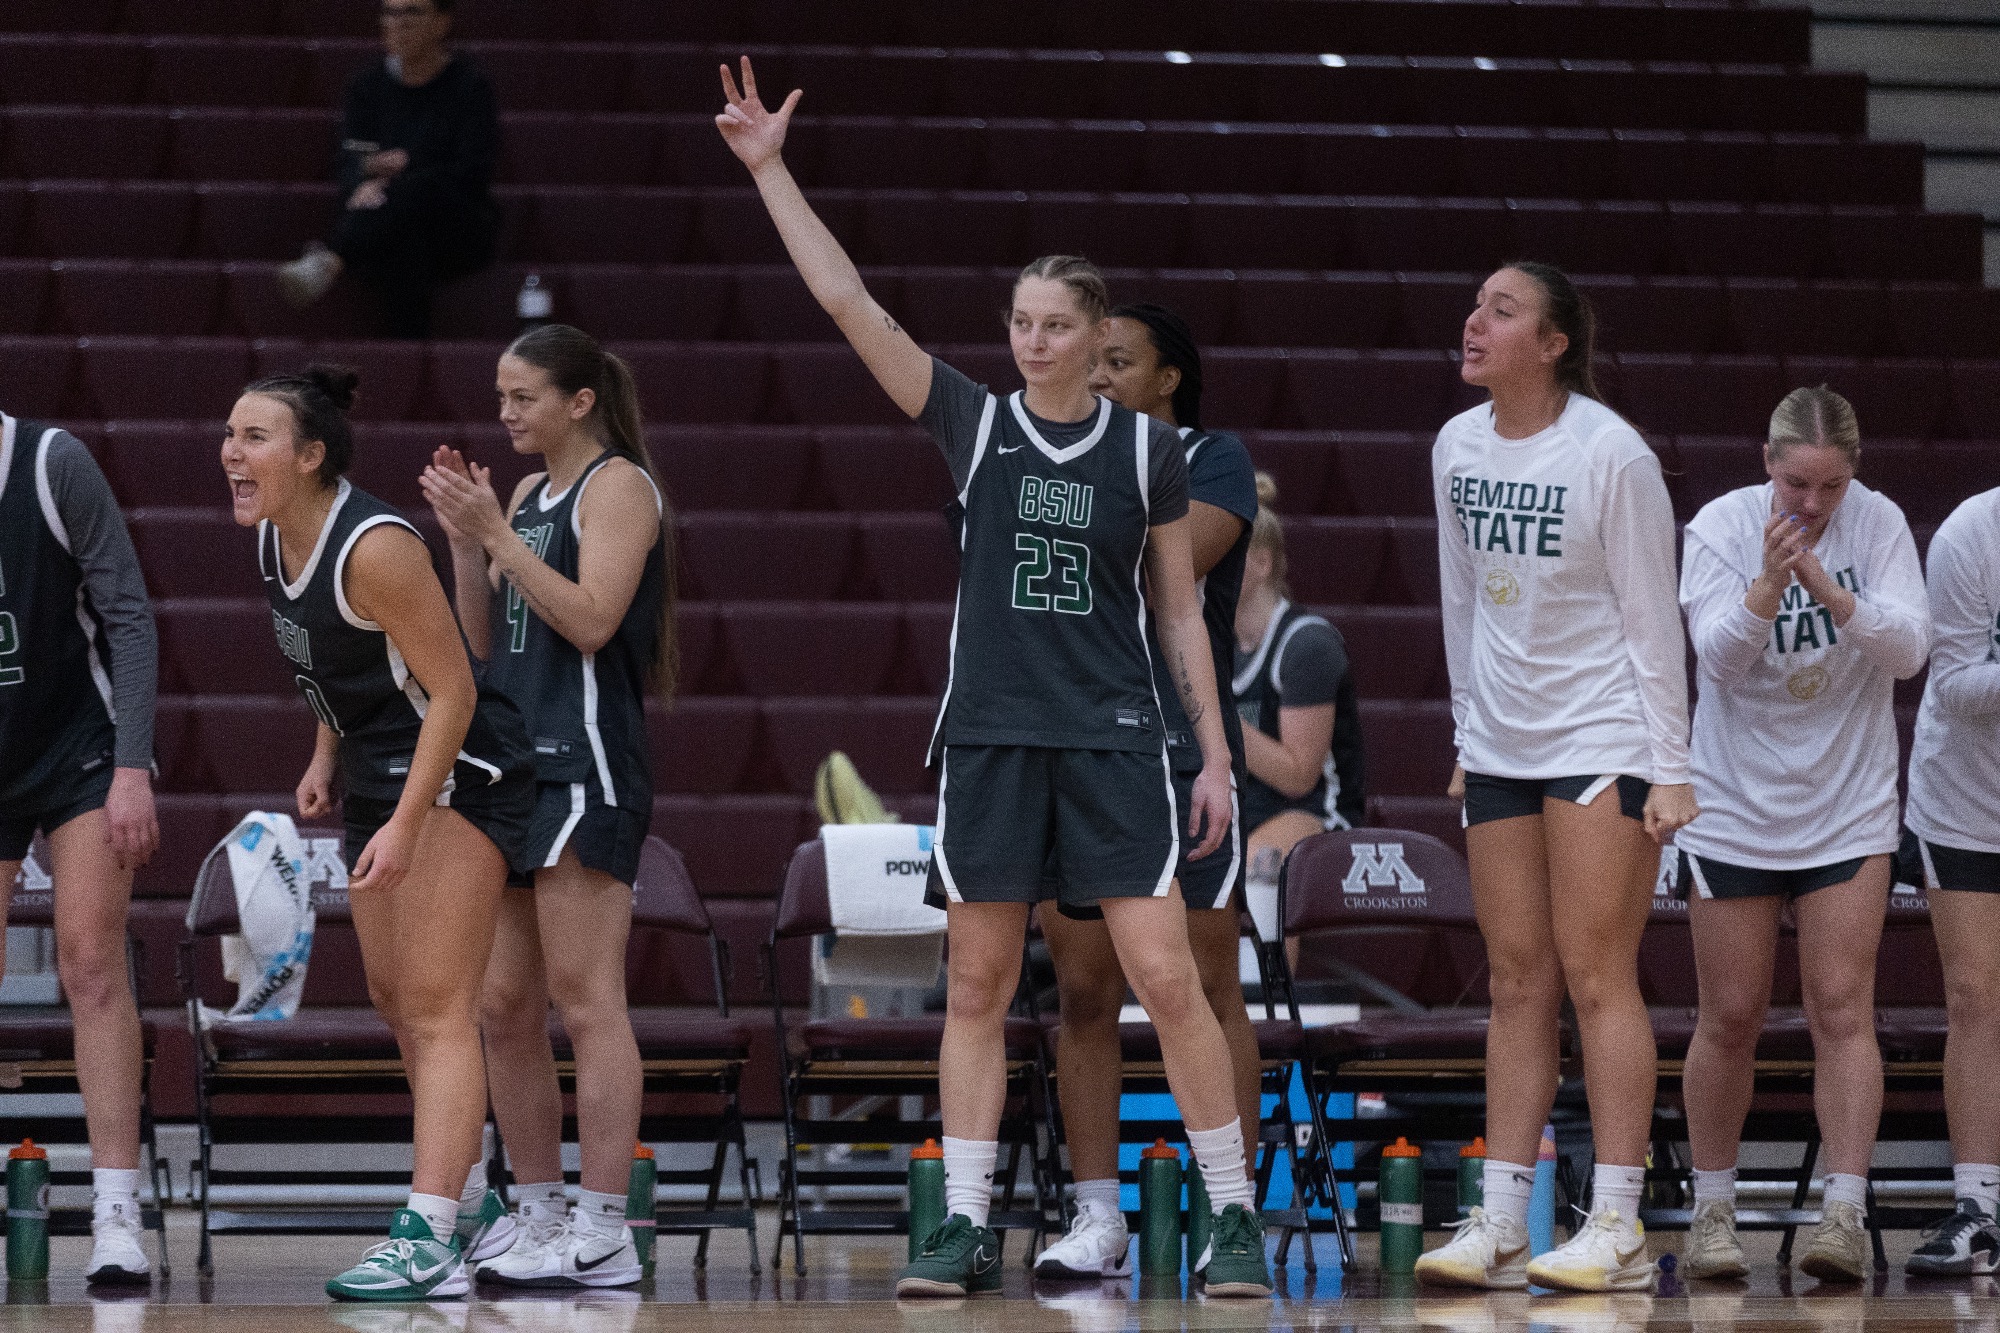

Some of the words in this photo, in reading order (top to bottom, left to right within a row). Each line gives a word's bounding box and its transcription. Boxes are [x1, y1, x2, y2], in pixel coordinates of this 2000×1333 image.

[1018, 475, 1094, 529] BSU
[1450, 475, 1568, 515] BEMIDJI
[1011, 533, 1093, 616] 23
[506, 581, 529, 652] 4
[1341, 842, 1426, 894] M
[1343, 895, 1428, 910] CROOKSTON
